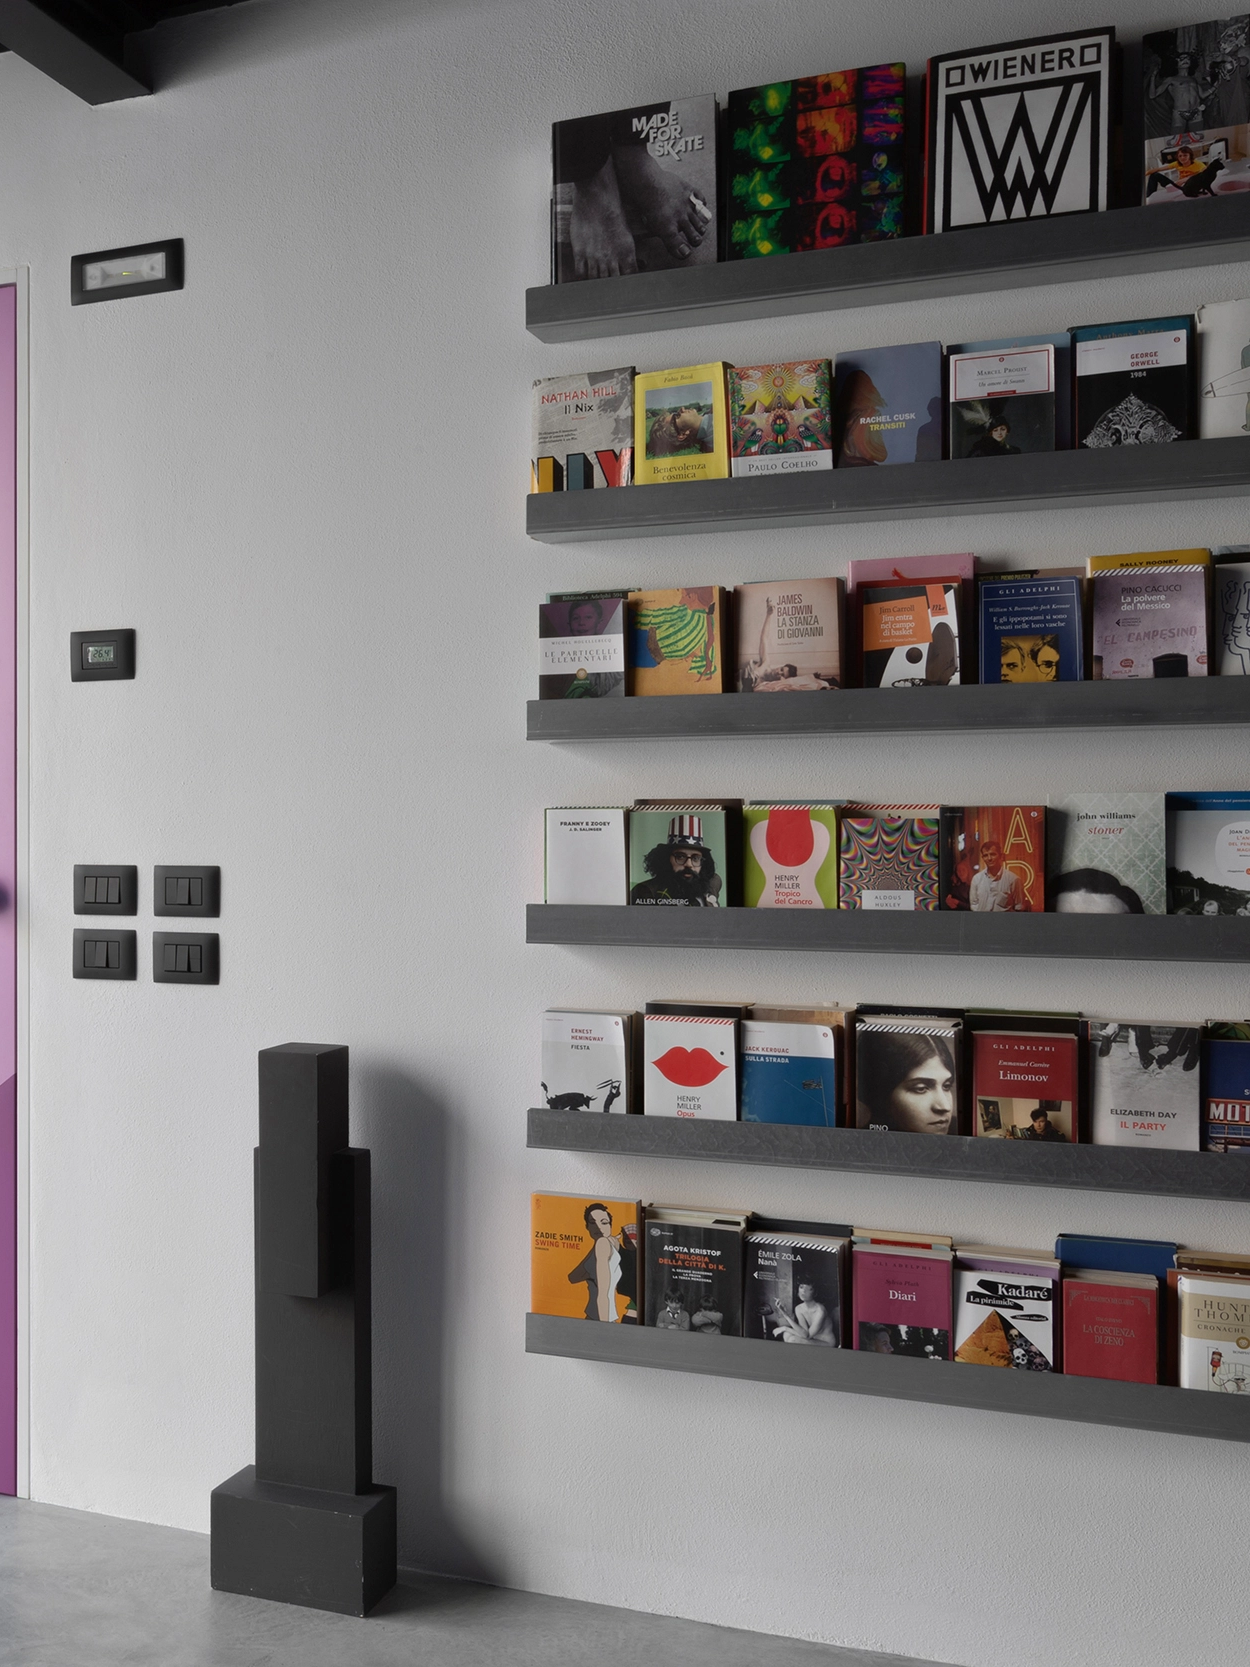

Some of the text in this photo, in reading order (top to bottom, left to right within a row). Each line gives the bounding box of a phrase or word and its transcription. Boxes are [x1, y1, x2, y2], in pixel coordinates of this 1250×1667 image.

[969, 47, 1076, 83] WIENER
[631, 111, 678, 139] MADE
[649, 125, 682, 144] FOR
[655, 134, 704, 161] SKATE
[1130, 351, 1158, 360] GEORGE
[1130, 359, 1160, 367] ORWELL
[541, 386, 617, 404] NATHAN HILL
[575, 402, 594, 414] Nix
[860, 412, 916, 425] RACHEL CUSK
[869, 422, 906, 432] TRANSITI
[653, 463, 706, 474] Benevolenza
[748, 460, 818, 472] PAULO COELHO
[662, 472, 696, 481] cosmica
[1019, 586, 1060, 595] ADELPHI
[1121, 584, 1181, 594] PINO CACUCCI
[777, 593, 803, 606] JAMES
[1134, 594, 1166, 603] polvere
[777, 604, 813, 617] BALDWIN
[879, 605, 915, 615] Jim Carroll
[1121, 602, 1171, 611] del Messico
[777, 615, 819, 628] LA STANZA
[882, 615, 894, 623] Jim
[892, 622, 915, 630] campo
[778, 626, 824, 639] DI GIOVANNI
[891, 628, 913, 636] basket
[561, 648, 619, 657] PARTICELLE
[551, 655, 612, 664] ELEMENTARI
[1077, 813, 1097, 821] john
[1088, 826, 1124, 835] stoner
[774, 882, 801, 890] MILLER
[775, 890, 801, 898] Tropico
[657, 898, 689, 906] GINSBERG
[765, 1056, 790, 1064] STRADA
[999, 1070, 1049, 1082] Limonov
[676, 1095, 701, 1103] HENRY
[676, 1102, 702, 1111] MILLER
[676, 1109, 695, 1119] Opus
[1110, 1109, 1177, 1119] ELIZABETH DAY
[869, 1124, 889, 1132] PINO
[1120, 1121, 1166, 1131] IL PARTY
[535, 1231, 584, 1243] ZADIE SMITH
[535, 1239, 581, 1251] SWING TIME
[663, 1245, 722, 1257] AGOTA KRISTOF
[675, 1253, 710, 1263] TRILOGIA
[781, 1252, 803, 1262] ZOLA
[658, 1257, 683, 1266] DELLA
[684, 1260, 707, 1269] CITTÀ
[888, 1289, 917, 1302] Diari
[997, 1283, 1048, 1299] Kadaré
[970, 1295, 979, 1303] La
[1083, 1324, 1136, 1338] LA COSCIENZA
[1197, 1324, 1246, 1334] CRONACHE
[1094, 1335, 1125, 1347] DI ZENO
